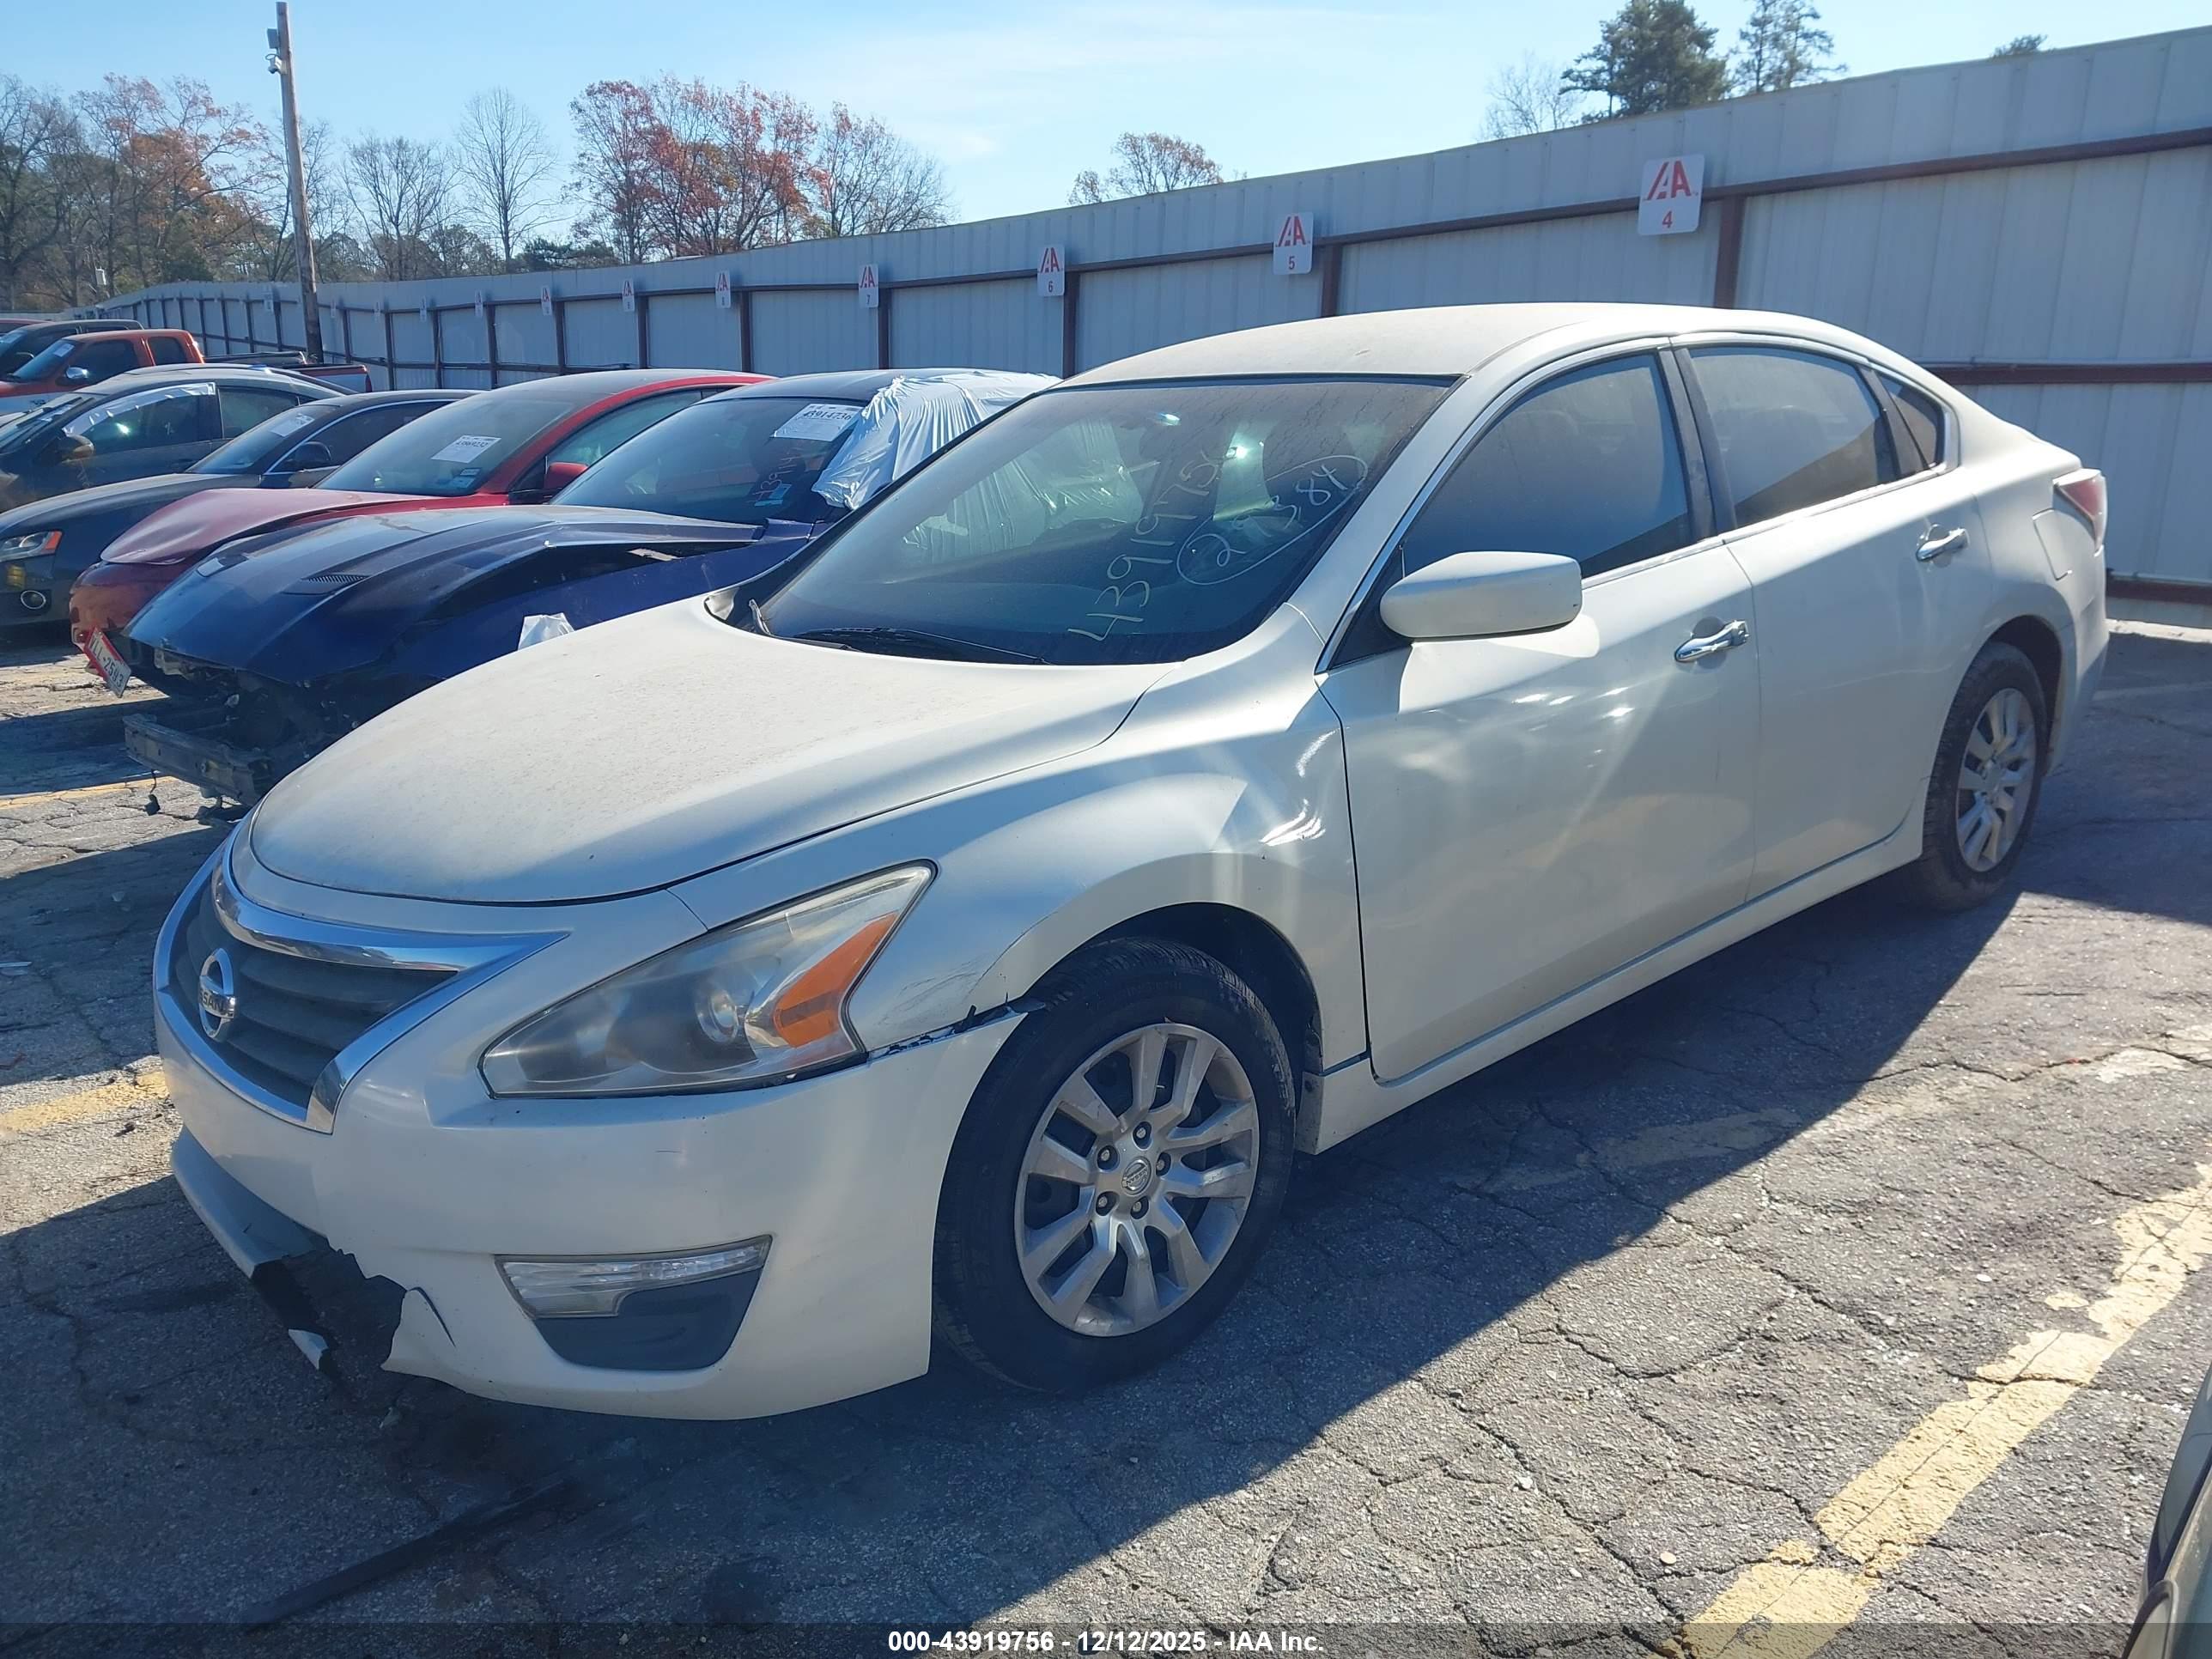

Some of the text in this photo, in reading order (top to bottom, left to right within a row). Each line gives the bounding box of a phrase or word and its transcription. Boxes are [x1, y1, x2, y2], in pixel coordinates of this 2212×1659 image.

[1662, 210, 1673, 229] 4
[1288, 256, 1296, 270] 5
[1048, 280, 1054, 293] 6
